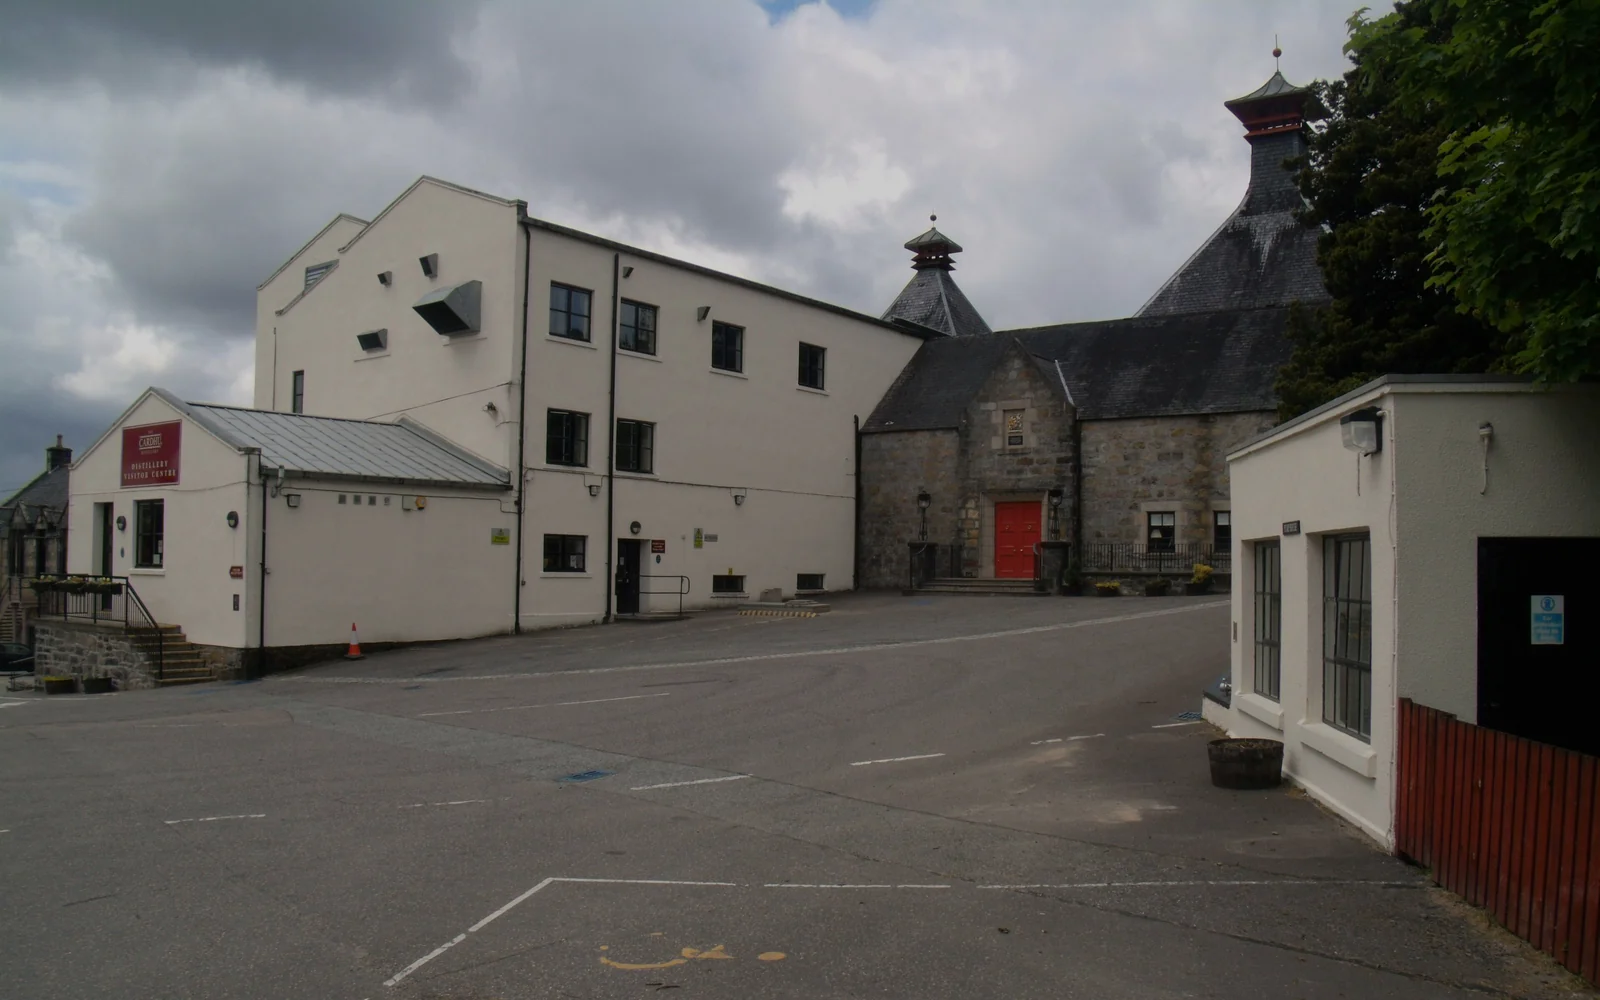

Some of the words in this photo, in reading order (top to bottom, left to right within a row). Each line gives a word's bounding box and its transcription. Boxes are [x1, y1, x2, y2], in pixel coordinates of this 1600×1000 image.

[139, 436, 162, 448] CARDHU
[131, 460, 168, 470] DISTILLERY
[124, 471, 149, 480] VISITOR
[151, 469, 176, 478] CENTRE
